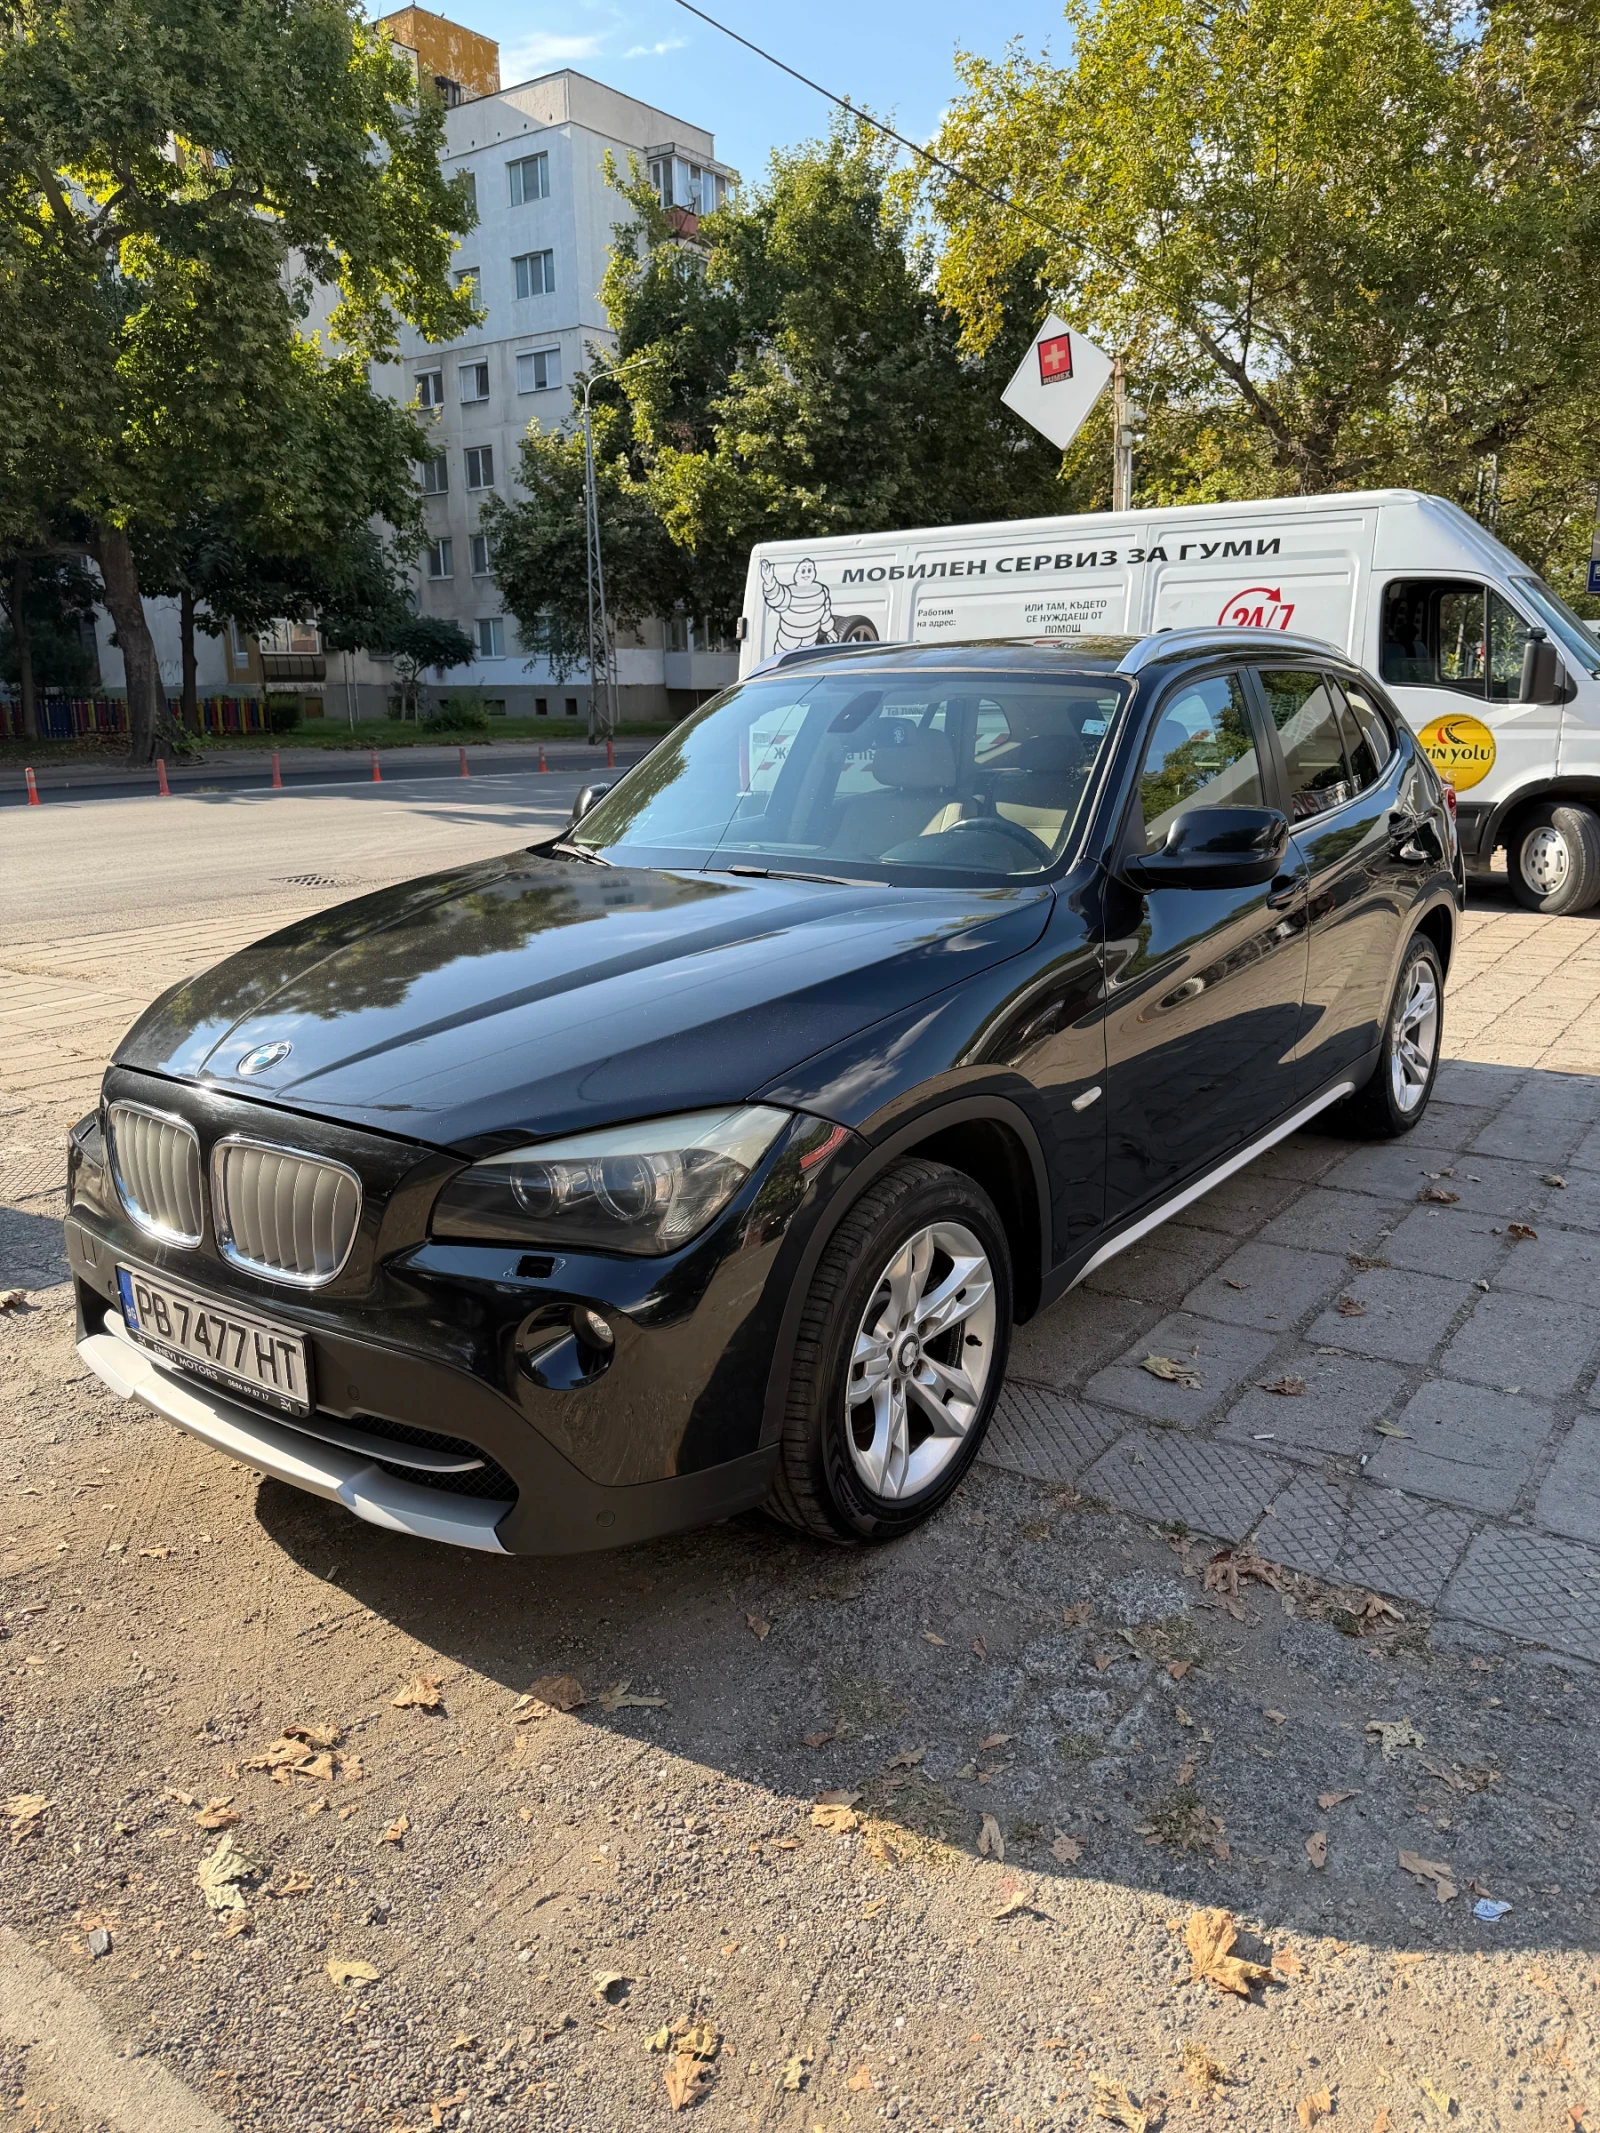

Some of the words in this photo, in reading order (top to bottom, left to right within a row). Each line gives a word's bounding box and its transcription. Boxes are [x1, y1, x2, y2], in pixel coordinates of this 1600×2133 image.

[1043, 371, 1071, 384] RUMEX
[841, 559, 987, 583] МОБИЛЕН
[995, 550, 1118, 573] СЕРВИЗ
[1126, 546, 1169, 564] ЗА
[1178, 538, 1281, 561] ГУМИ
[1024, 603, 1044, 612] ИЛИ
[1045, 602, 1067, 611] ТАМ,
[1069, 599, 1107, 610] КЪДЕТО
[917, 608, 954, 617] Работим
[1026, 615, 1038, 623] СЕ
[1039, 612, 1089, 622] НУЖДАЕШ
[1090, 611, 1103, 620] ОТ
[1232, 604, 1295, 630] 24/7
[153, 1343, 177, 1361] ENEVI
[180, 1357, 218, 1380] MOTORS
